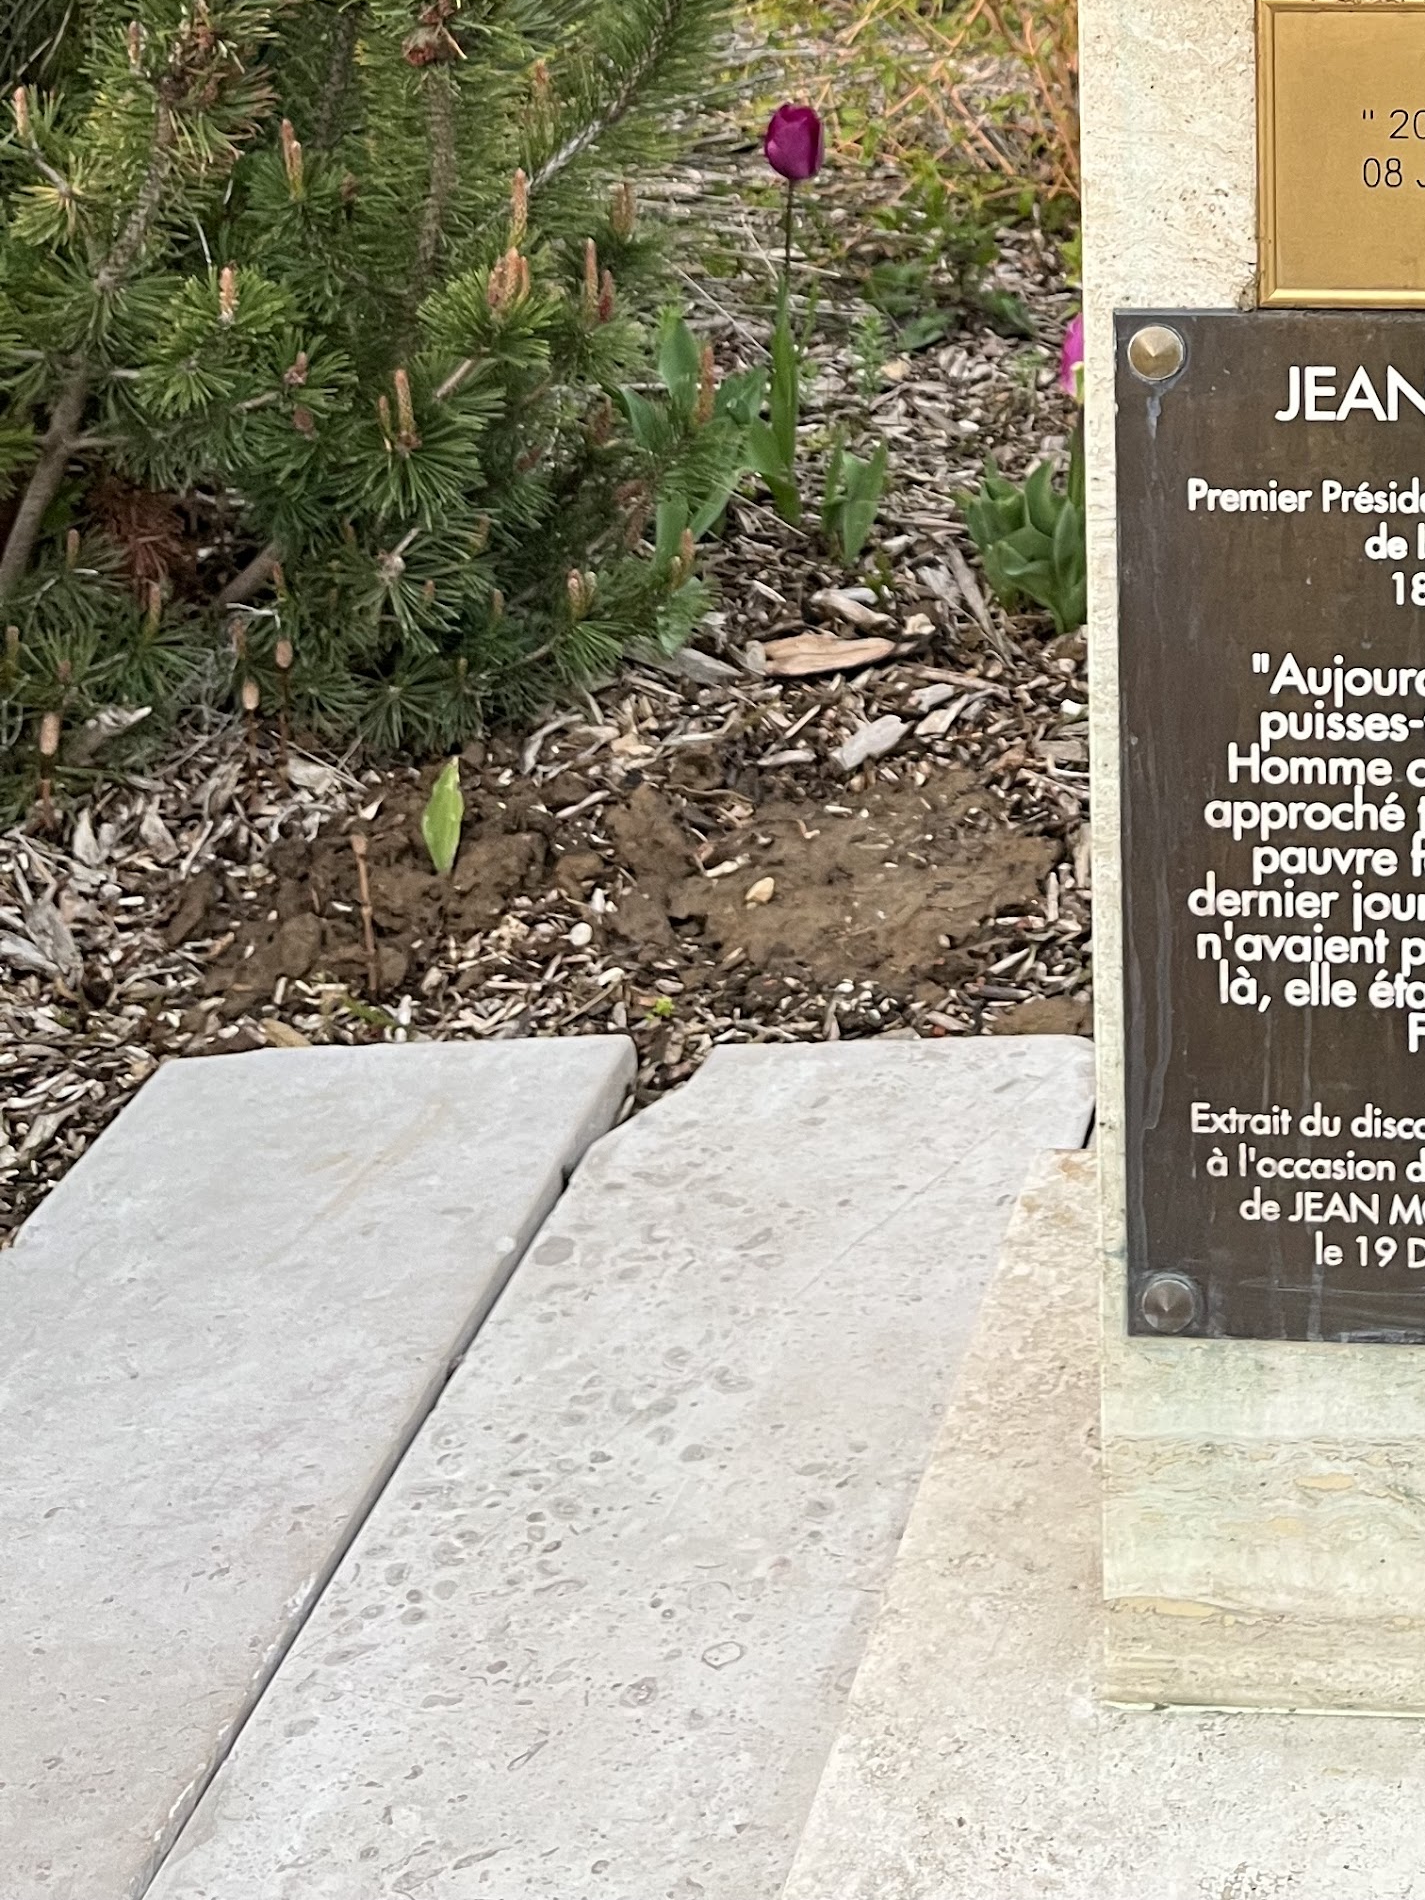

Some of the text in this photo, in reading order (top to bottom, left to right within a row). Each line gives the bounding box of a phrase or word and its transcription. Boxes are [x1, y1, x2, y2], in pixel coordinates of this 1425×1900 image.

[1362, 158, 1404, 189] 08
[1187, 478, 1312, 513] Premier
[1364, 525, 1408, 561] de
[1227, 742, 1392, 786] Homme
[1204, 785, 1405, 840] approché
[1252, 844, 1398, 884] pauvre
[1187, 871, 1338, 919] dernier
[1197, 921, 1388, 964] n'avaient
[1219, 959, 1272, 1012] là,
[1284, 960, 1357, 1008] elle
[1191, 1103, 1291, 1138] Extrait
[1301, 1103, 1341, 1139] du
[1206, 1151, 1227, 1176] à
[1238, 1144, 1395, 1182] l'occasion
[1239, 1187, 1279, 1222] de
[1288, 1193, 1379, 1224] JEAN
[1314, 1231, 1342, 1265] le
[1355, 1235, 1398, 1267] 19
